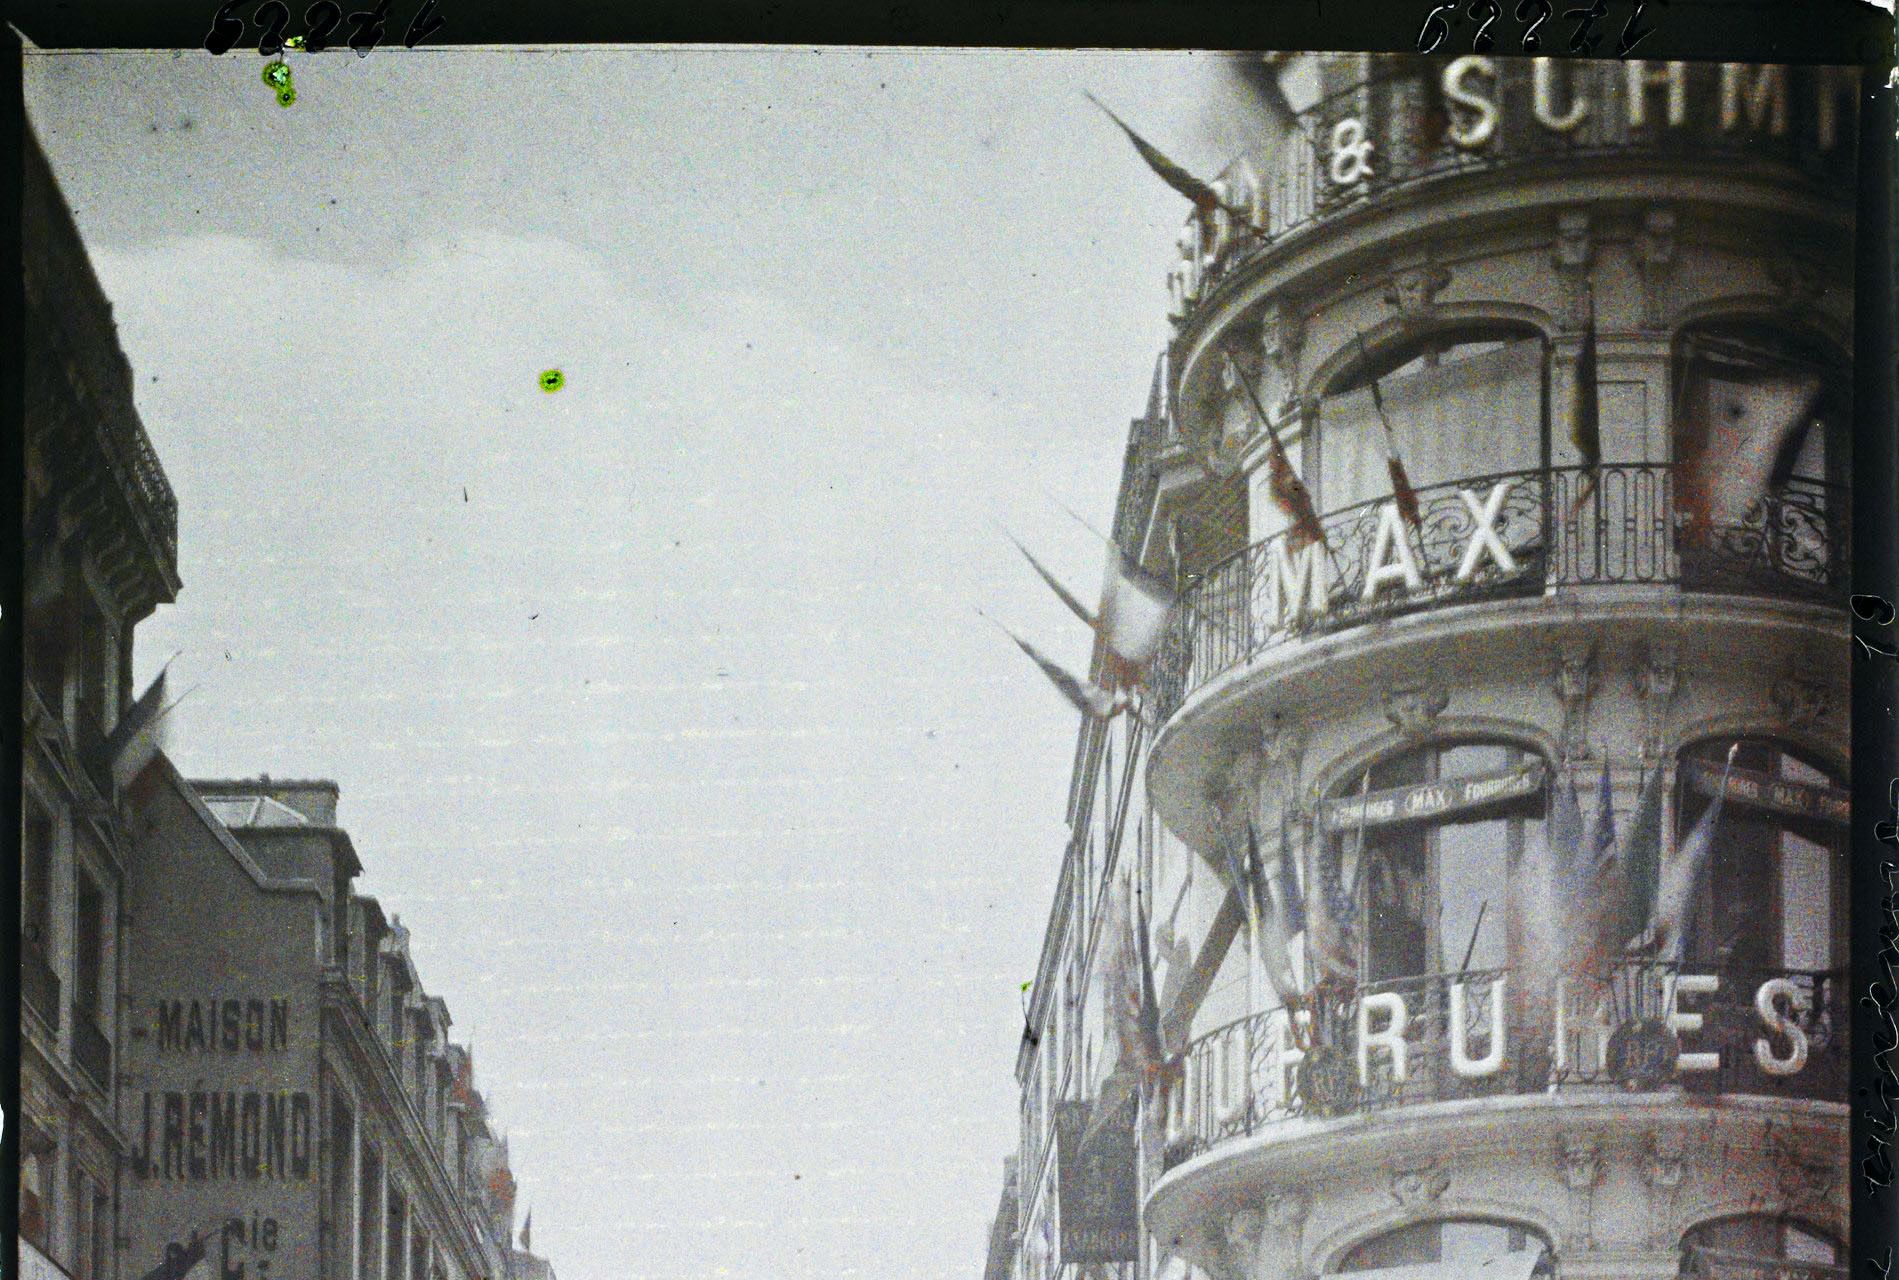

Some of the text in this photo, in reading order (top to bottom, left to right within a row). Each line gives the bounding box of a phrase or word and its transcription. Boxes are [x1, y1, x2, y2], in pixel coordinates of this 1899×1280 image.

[1331, 118, 1374, 184] &
[1271, 481, 1518, 626] MAX
[1411, 788, 1446, 811] MAX
[158, 999, 289, 1051] MAISON
